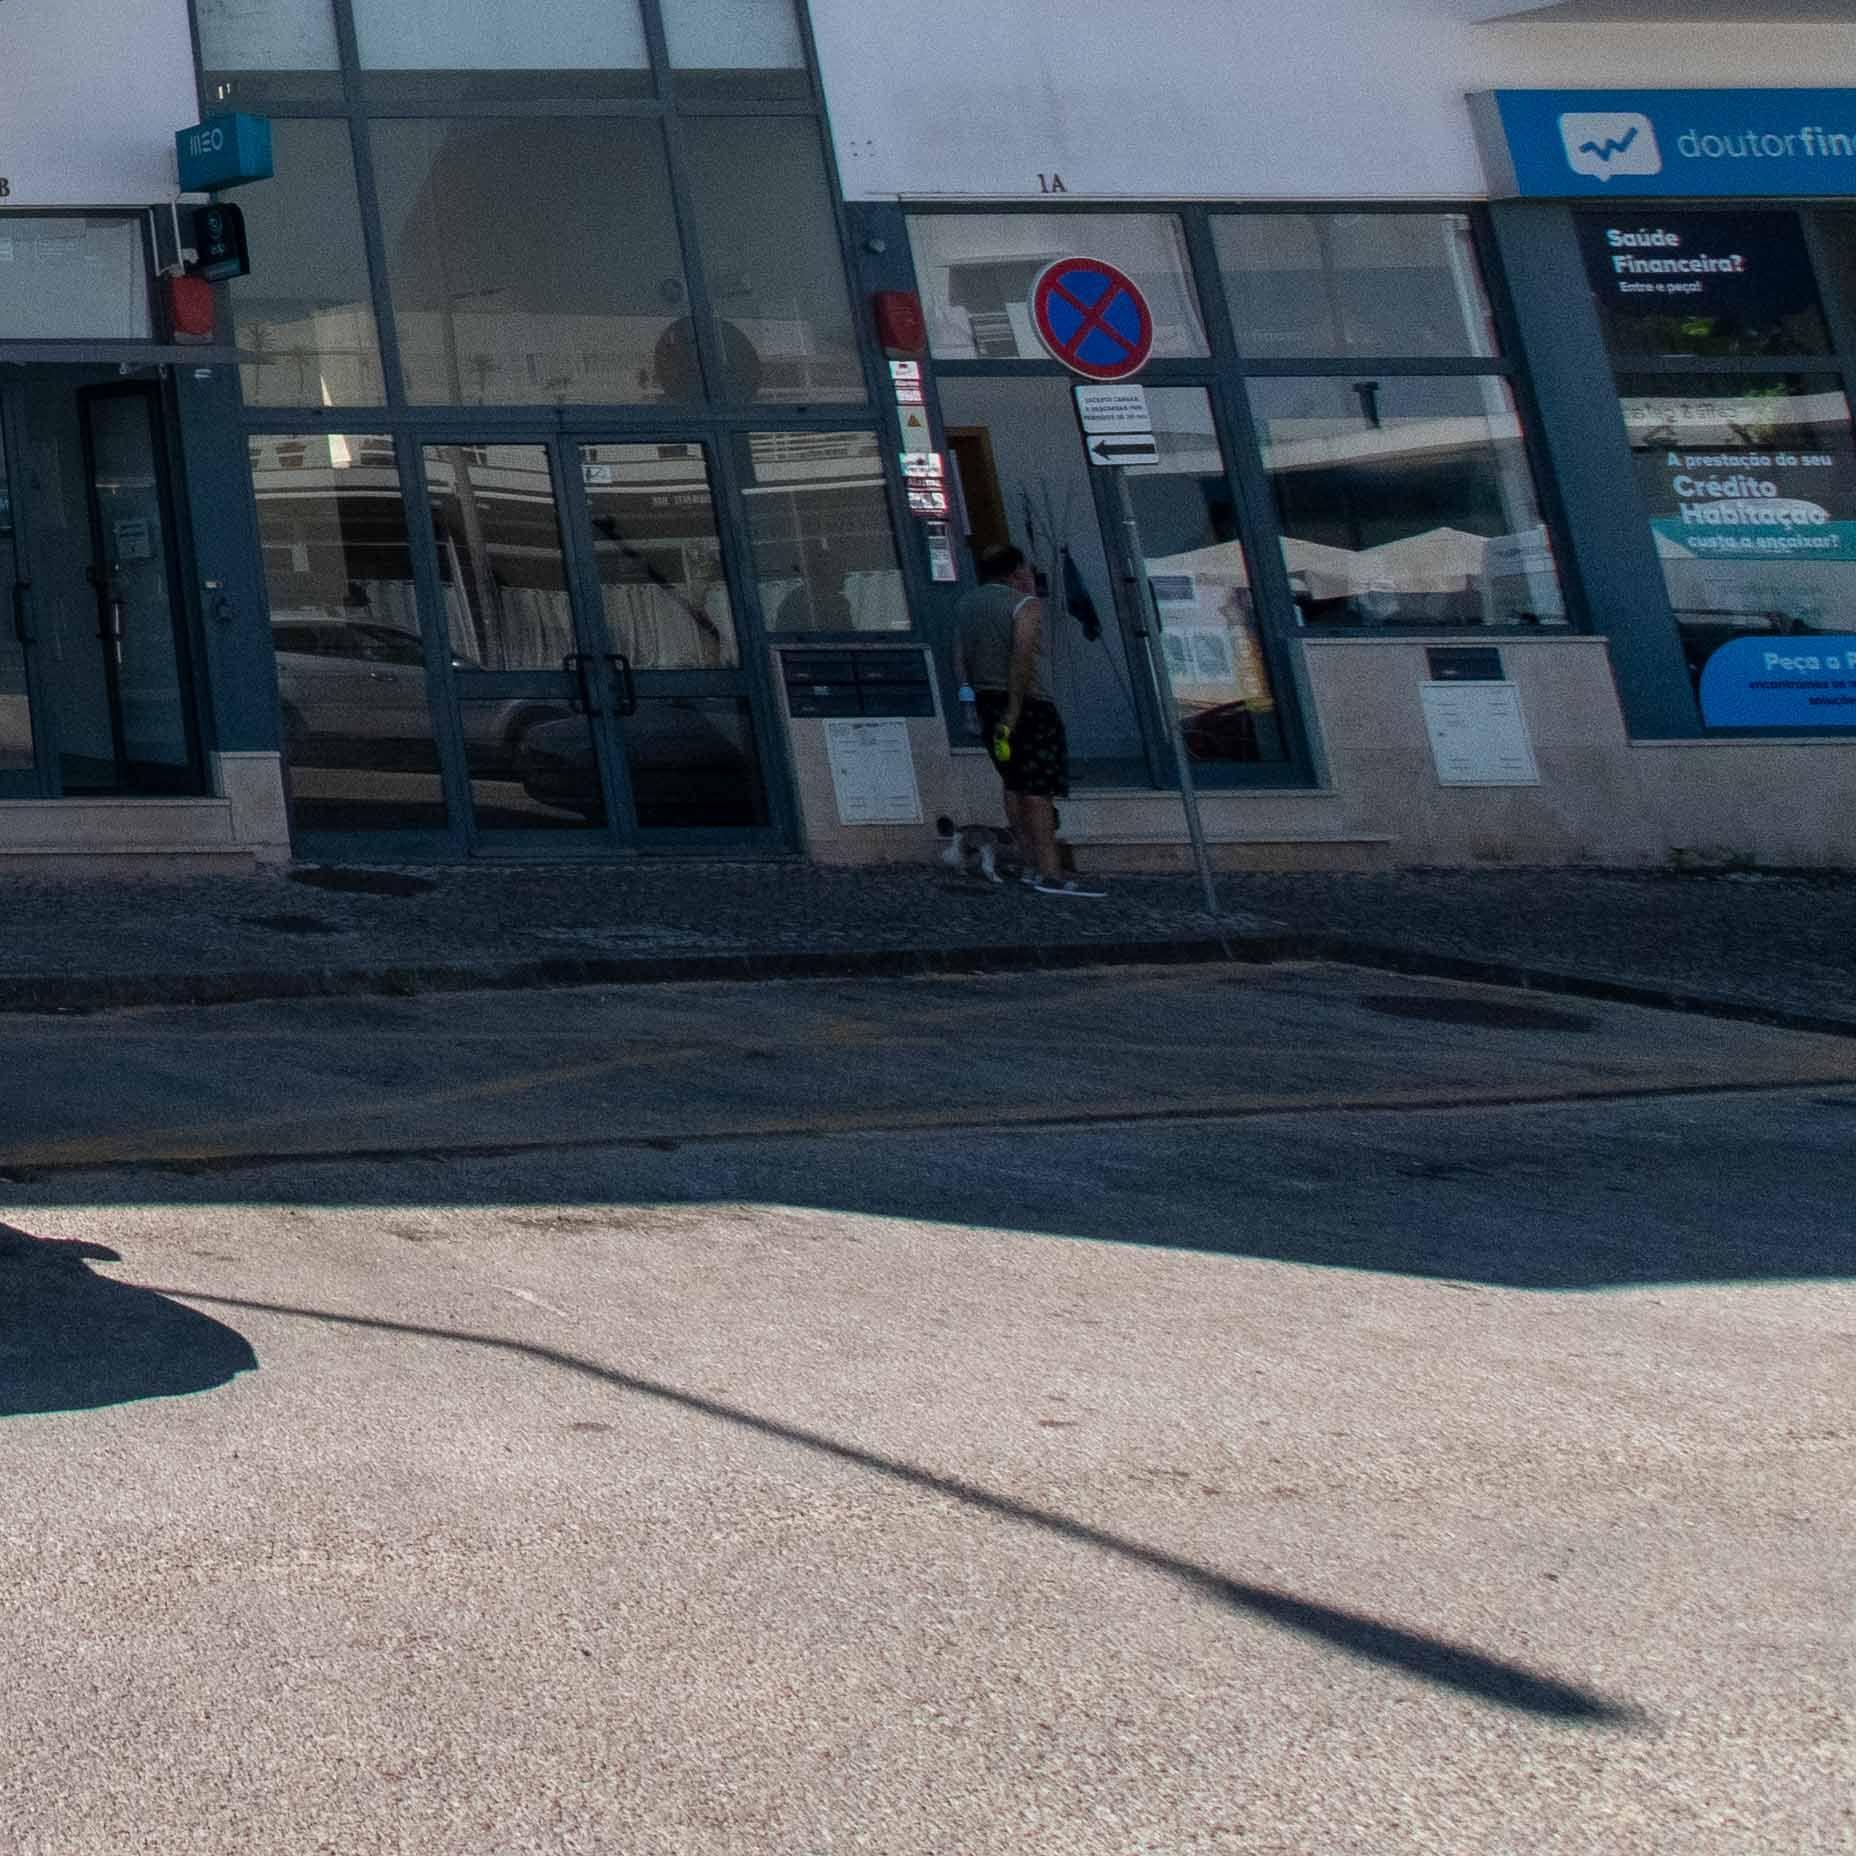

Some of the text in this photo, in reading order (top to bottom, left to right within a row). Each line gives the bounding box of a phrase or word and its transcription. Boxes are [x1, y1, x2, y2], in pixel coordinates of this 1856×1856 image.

[190, 128, 223, 156] MEO
[1678, 126, 1855, 157] doutorfin
[1037, 174, 1067, 193] 1A
[1606, 228, 1680, 247] Saúde
[1613, 254, 1745, 273] Financeira?
[1619, 281, 1654, 293] Entre
[1667, 452, 1679, 466] A
[1685, 452, 1771, 470] prestação
[1800, 454, 1833, 466] seu
[1672, 474, 1777, 498] Crédito
[1680, 502, 1826, 530] Habitação
[1762, 652, 1821, 675] Peça
